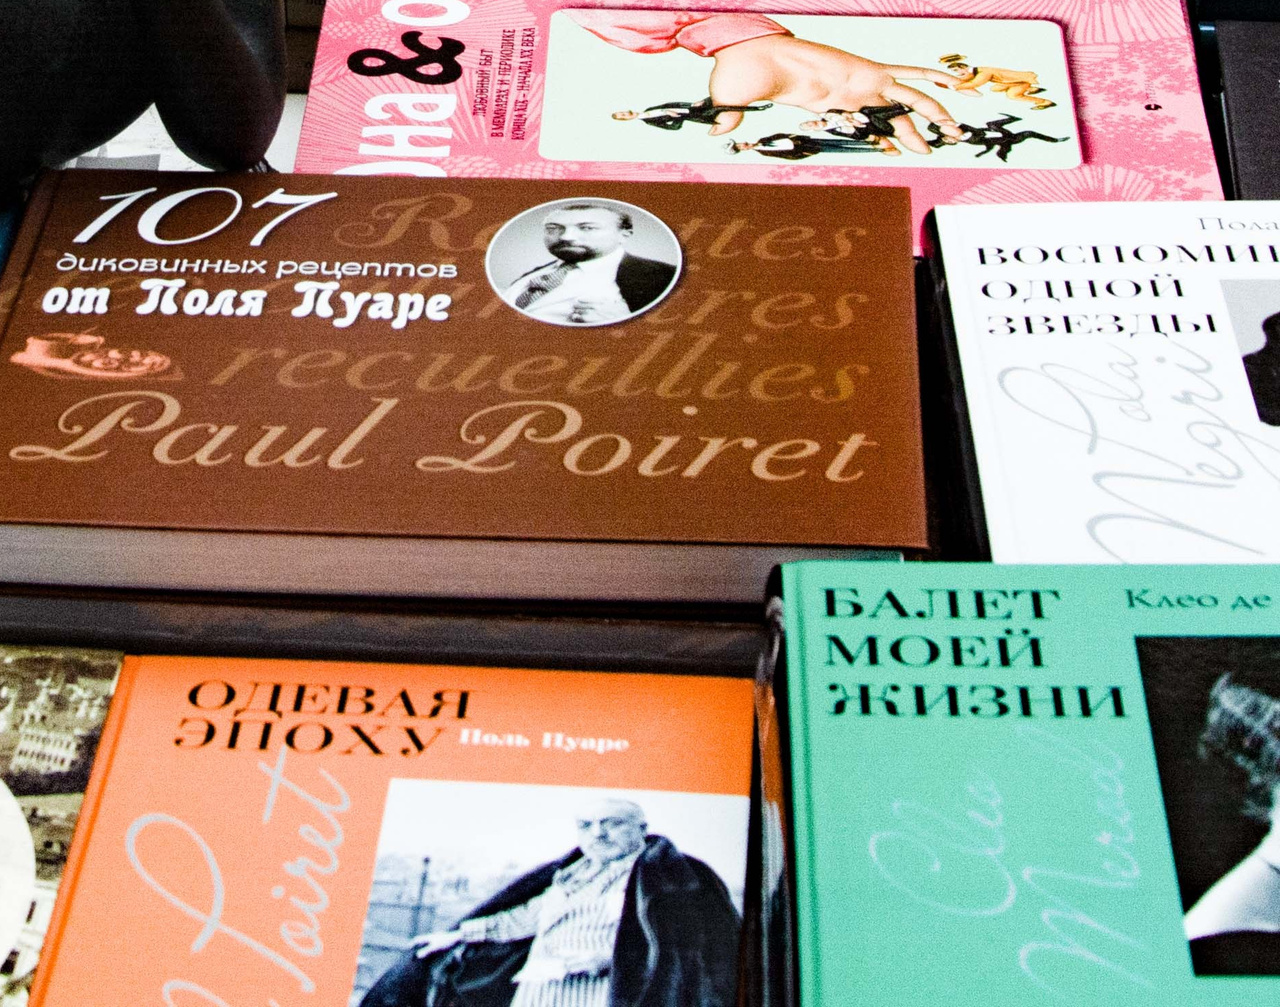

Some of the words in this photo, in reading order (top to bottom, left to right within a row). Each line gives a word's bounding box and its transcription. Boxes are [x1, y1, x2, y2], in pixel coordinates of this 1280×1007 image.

[520, 48, 532, 60] XX
[522, 27, 536, 47] ВЕКА
[480, 48, 493, 66] БЫТ
[492, 89, 509, 130] МЕМУАРАХ
[501, 29, 517, 77] ПЕРИОДИКЕ
[517, 60, 531, 91] НАЧАЛА
[472, 69, 493, 117] ЛЮБОВНЫЙ
[512, 112, 526, 141] КОНЦА
[72, 185, 339, 248] 107
[55, 252, 267, 276] диковинных
[275, 258, 458, 281] рецептов
[41, 285, 110, 315] от
[135, 278, 268, 318] Поля
[291, 279, 452, 330] Пуаре
[980, 273, 1186, 304] ОДНОЙ
[986, 312, 1220, 339] ЗВЕЗДЫ
[7, 390, 400, 471] Paul
[415, 400, 879, 483] Poiret
[820, 586, 1061, 620] БАЛЕТ
[1125, 587, 1220, 610] Клео
[1230, 592, 1272, 611] де
[823, 628, 1050, 669] МОЕЙ
[187, 678, 477, 721] ОДЕВАЯ
[826, 682, 1132, 720] ЖИЗНИ
[173, 717, 446, 757] ЭПОХУ
[458, 727, 530, 748] Поль
[541, 731, 631, 755] Пуаре
[125, 743, 352, 994] Poiret
